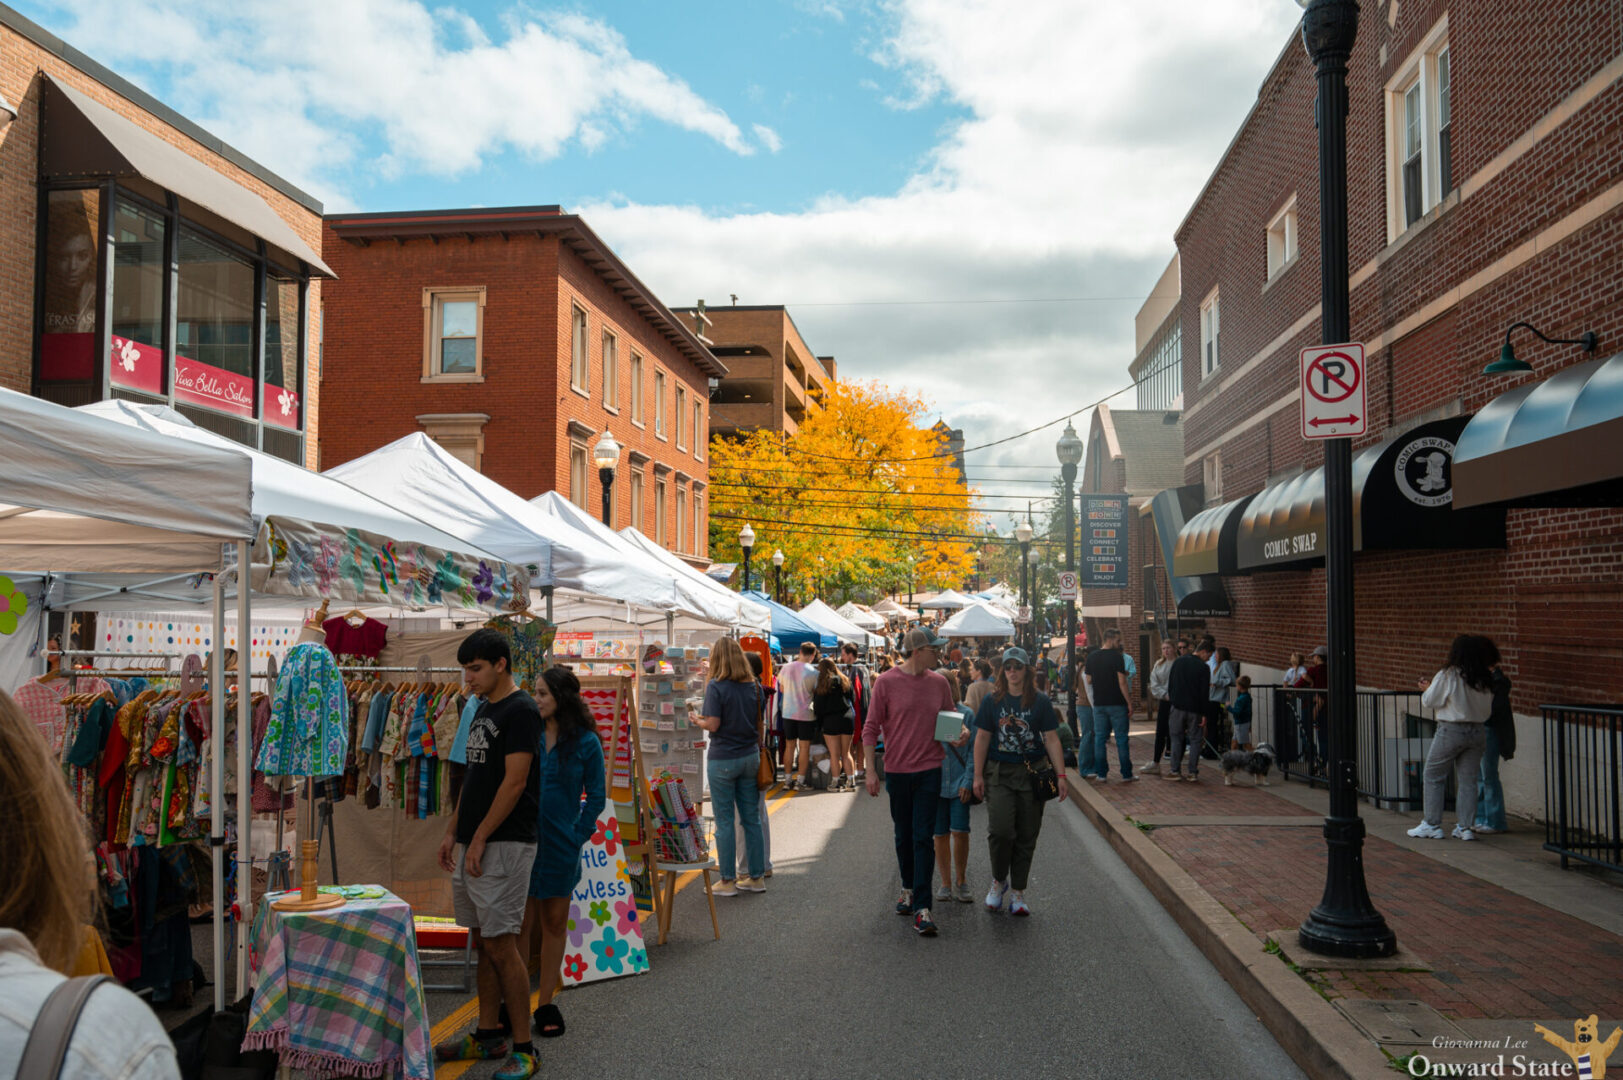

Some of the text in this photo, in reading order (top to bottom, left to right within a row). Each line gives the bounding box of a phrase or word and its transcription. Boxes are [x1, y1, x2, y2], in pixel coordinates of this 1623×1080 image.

[175, 367, 252, 404] Viva Bella Salon
[1398, 442, 1420, 471] COMIC
[1264, 531, 1317, 559] COMIC SWAP
[581, 848, 608, 868] tle
[571, 879, 627, 901] wless
